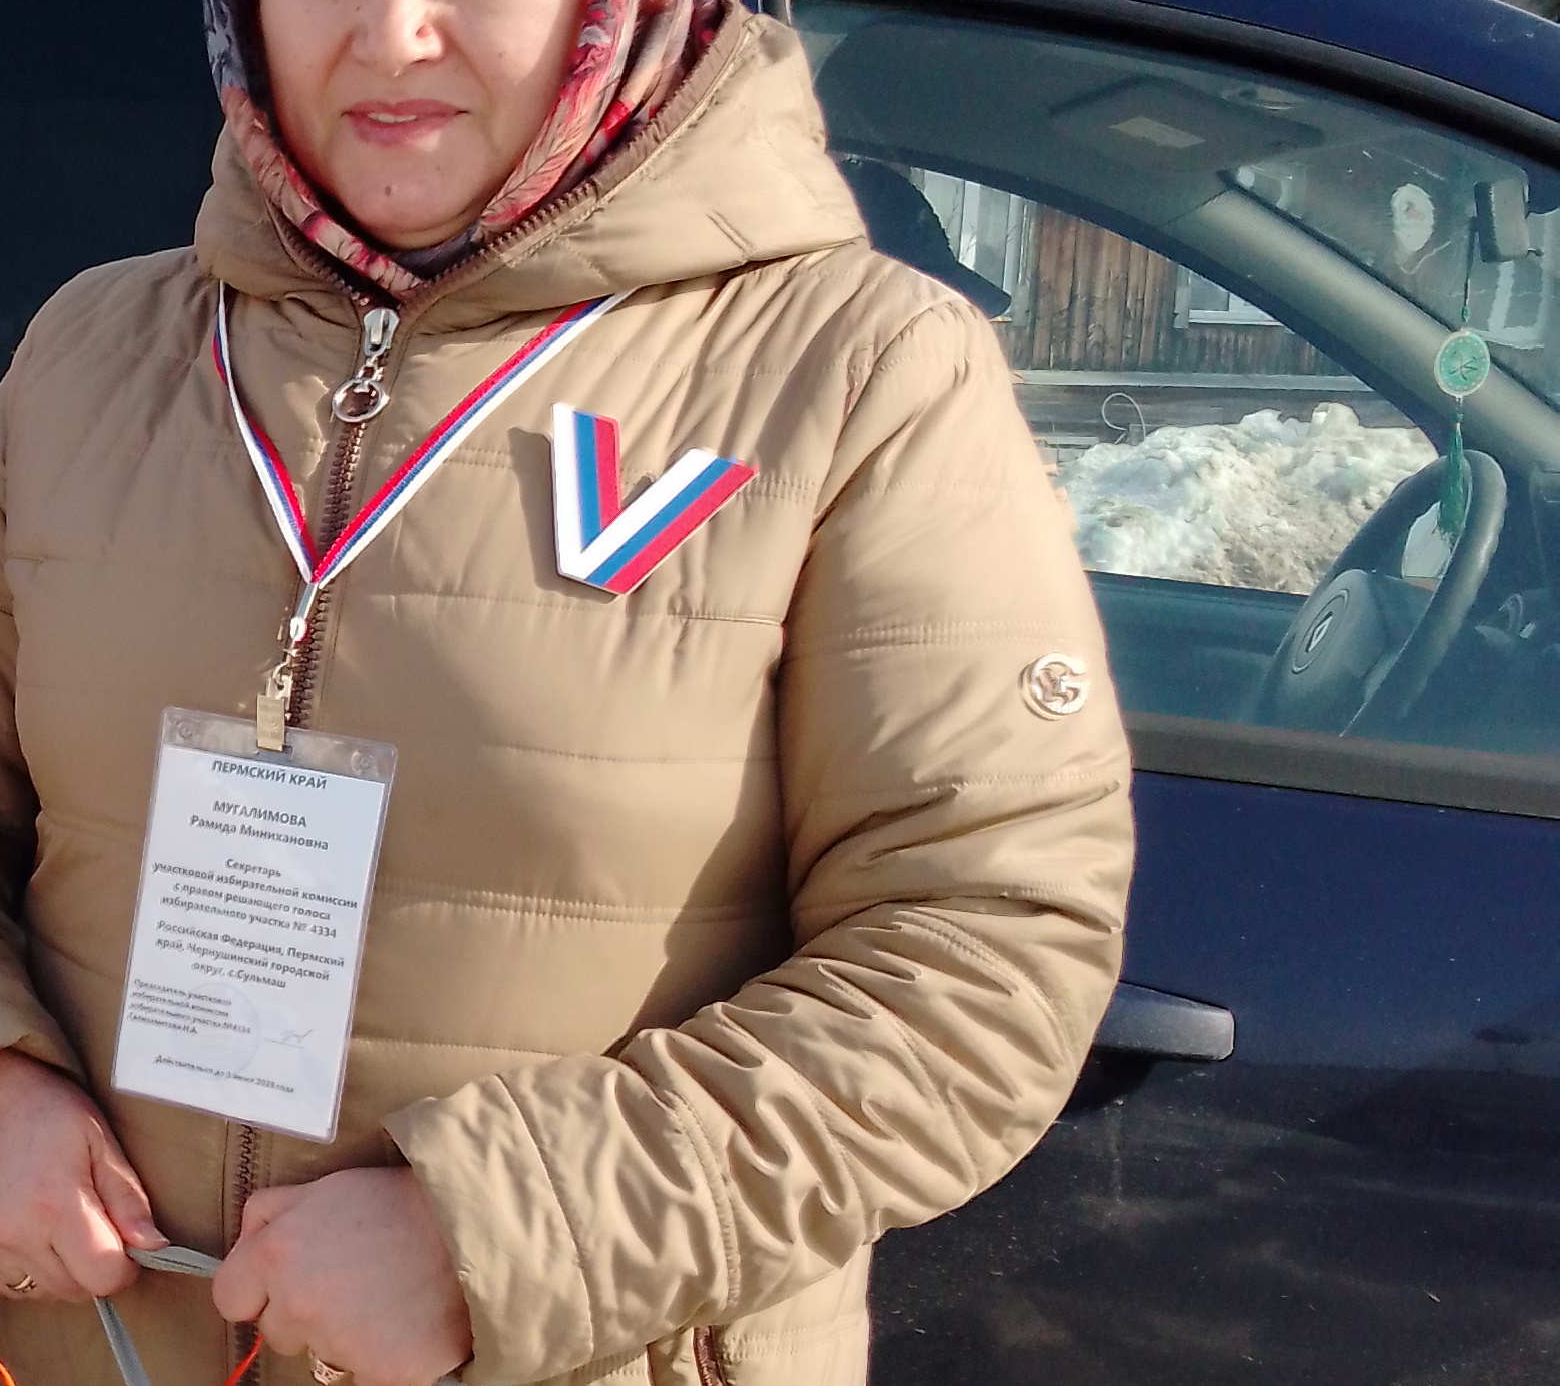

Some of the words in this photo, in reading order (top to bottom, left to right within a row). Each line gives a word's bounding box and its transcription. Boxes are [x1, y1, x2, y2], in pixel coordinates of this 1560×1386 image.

[212, 760, 285, 783] ПЕРМСКИЙ
[289, 775, 328, 790] КРАЙ
[190, 815, 237, 835] Рамида
[240, 824, 329, 850] Минихановна
[212, 801, 307, 828] МУГАЛИМОВА
[152, 862, 215, 881] участковой
[217, 874, 300, 898] избирательной
[301, 892, 358, 909] комиссии
[226, 858, 282, 878] Секретарь
[161, 897, 247, 920] избирательного
[249, 913, 290, 929] участка
[309, 924, 338, 938] 4334
[183, 885, 223, 900] правом
[225, 894, 290, 913] решающего
[292, 907, 331, 921] голоса
[156, 920, 219, 942] Российская
[221, 934, 284, 957] Федерация,
[287, 947, 346, 968] Пермский
[188, 943, 269, 968] Чернушинский
[270, 961, 330, 982] городской
